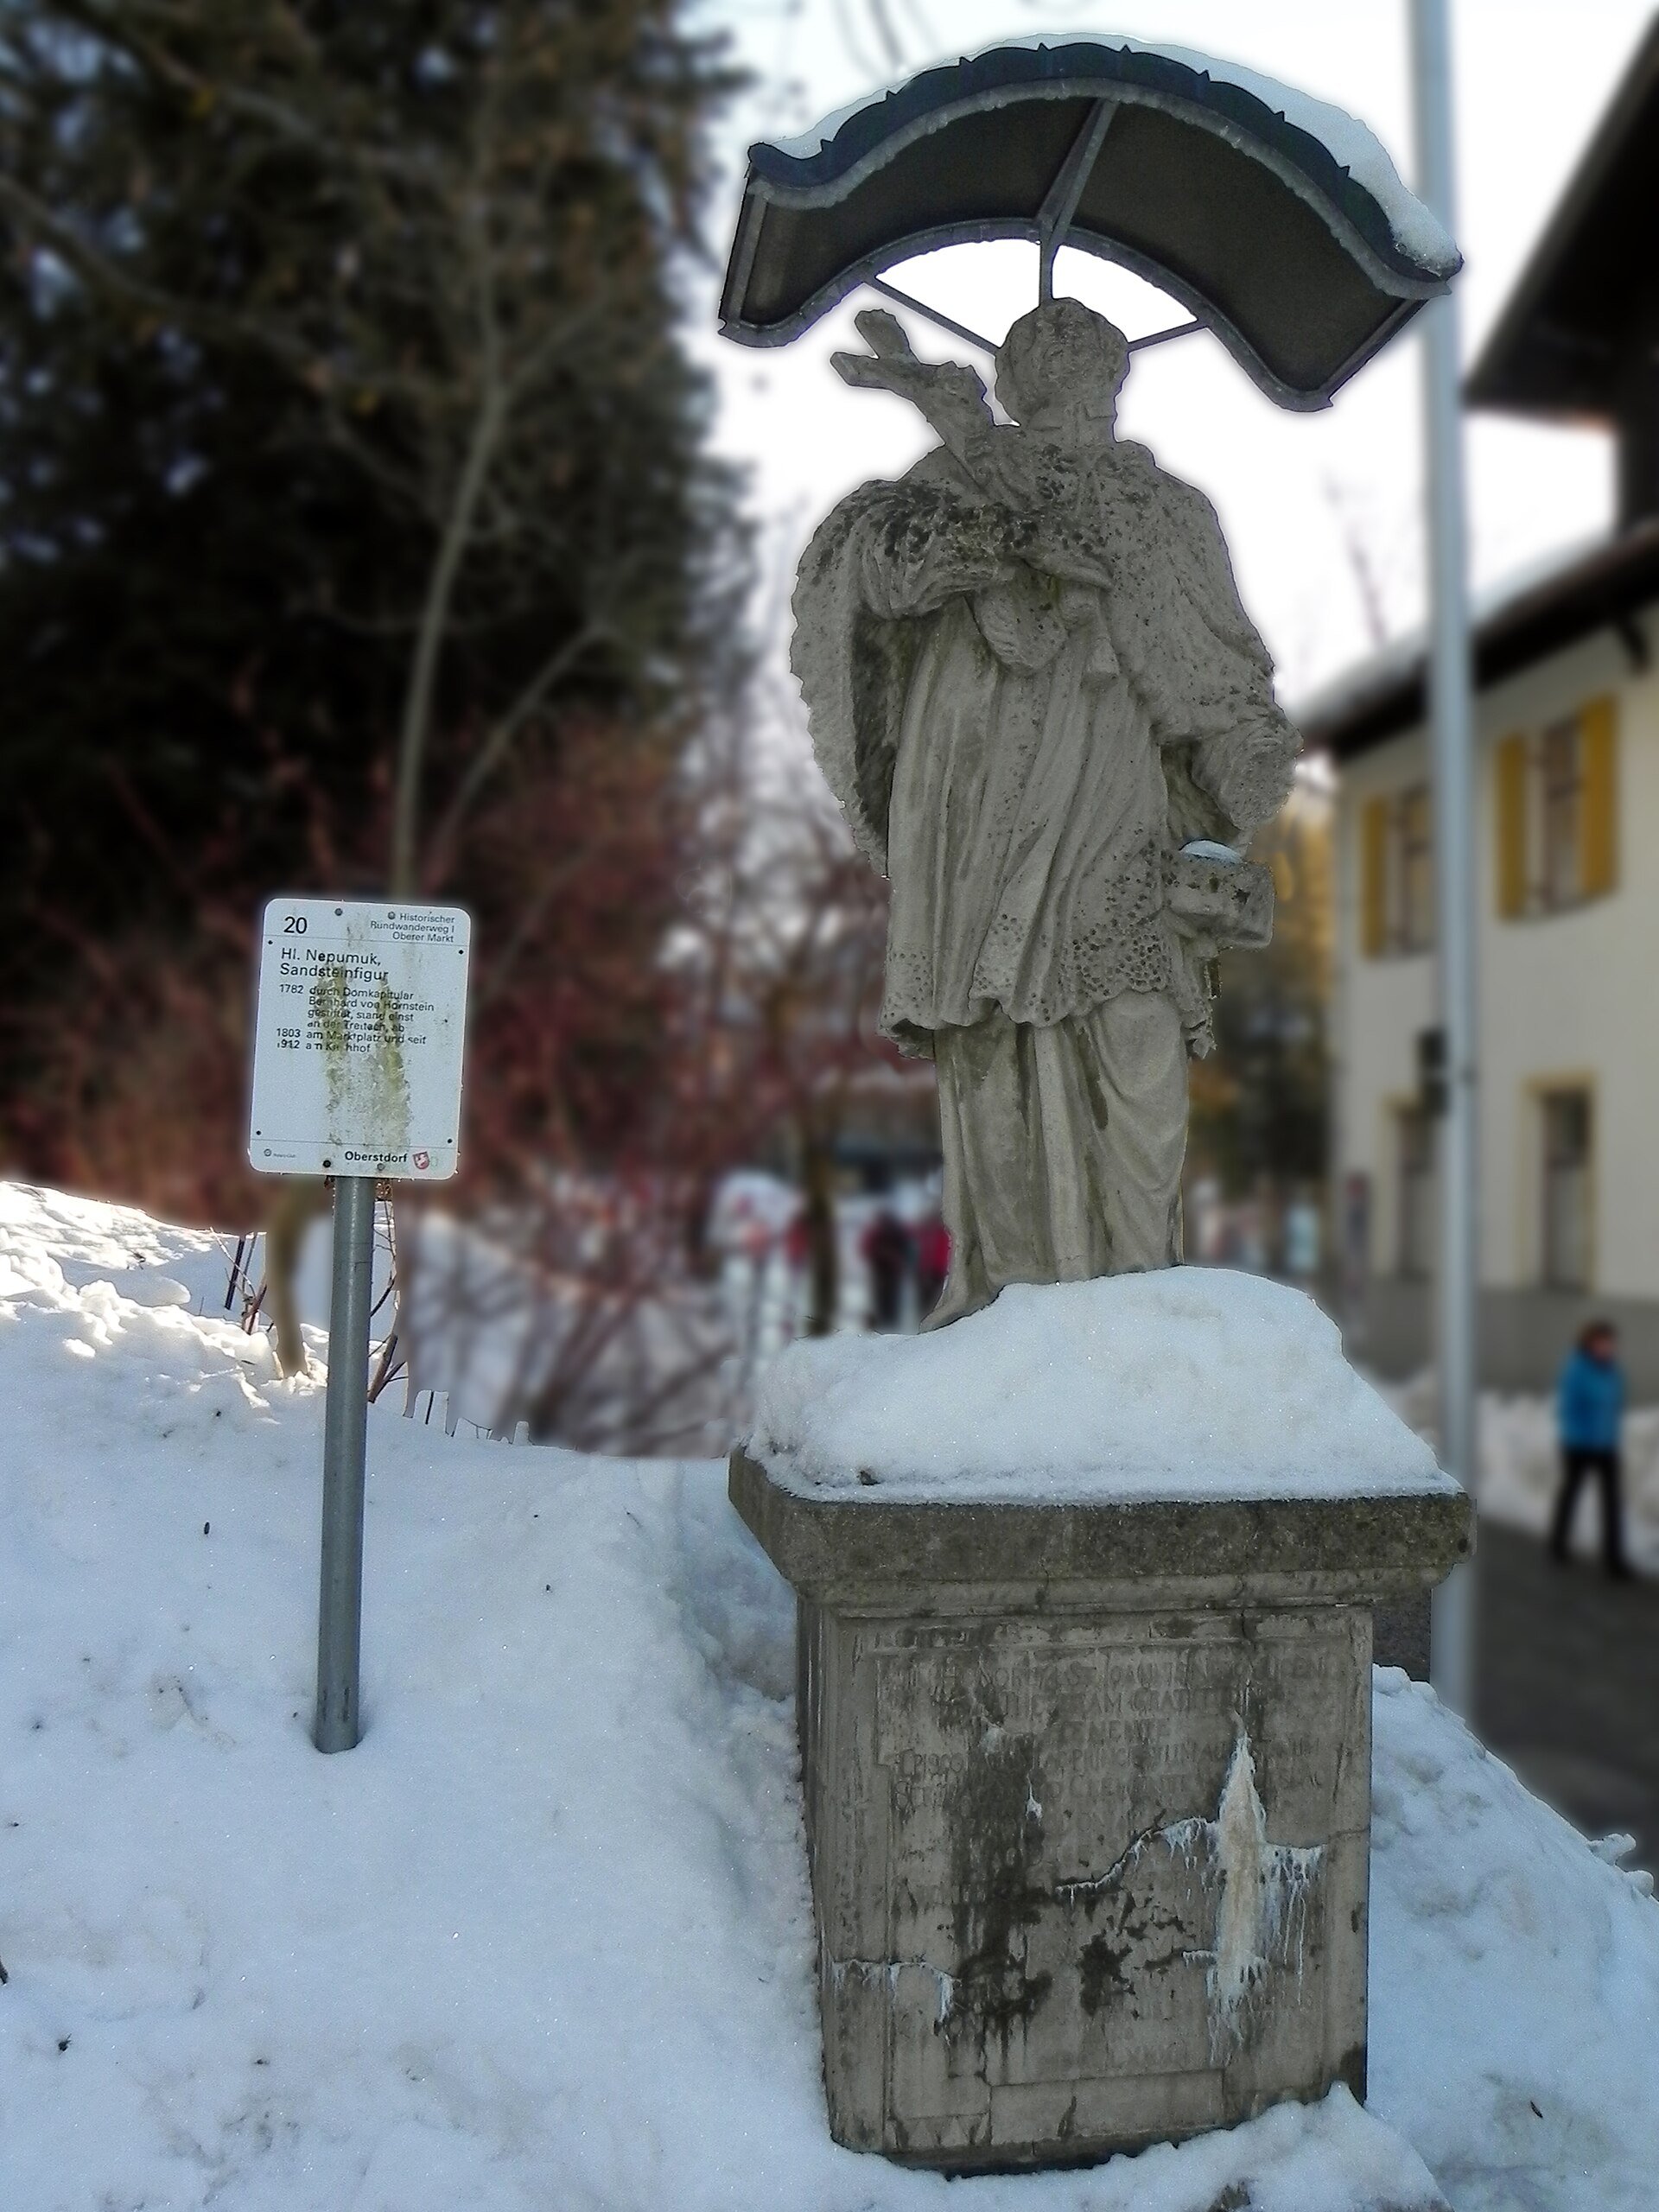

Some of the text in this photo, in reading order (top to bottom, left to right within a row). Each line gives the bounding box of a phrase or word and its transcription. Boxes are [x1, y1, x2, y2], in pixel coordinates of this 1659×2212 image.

[283, 916, 308, 934] 20
[399, 912, 455, 924] Historischer
[370, 920, 449, 934] Rundwanderweg
[392, 931, 454, 943] Oberer Markt
[281, 947, 381, 967] Hl. Nepumuk,
[279, 963, 389, 982] Sandsteinfigur
[279, 984, 414, 1000] 1782 durch Domkapitular
[308, 996, 357, 1007] Bernhard
[384, 1000, 435, 1011] Hornstein
[356, 1011, 385, 1020] stand
[389, 1012, 414, 1022] einst
[323, 1020, 340, 1028] der
[276, 1028, 302, 1038] 1803
[326, 1031, 381, 1043] Marktplatz
[384, 1034, 405, 1044] und
[408, 1035, 426, 1045] seit
[345, 1151, 408, 1163] Oberstdorf
